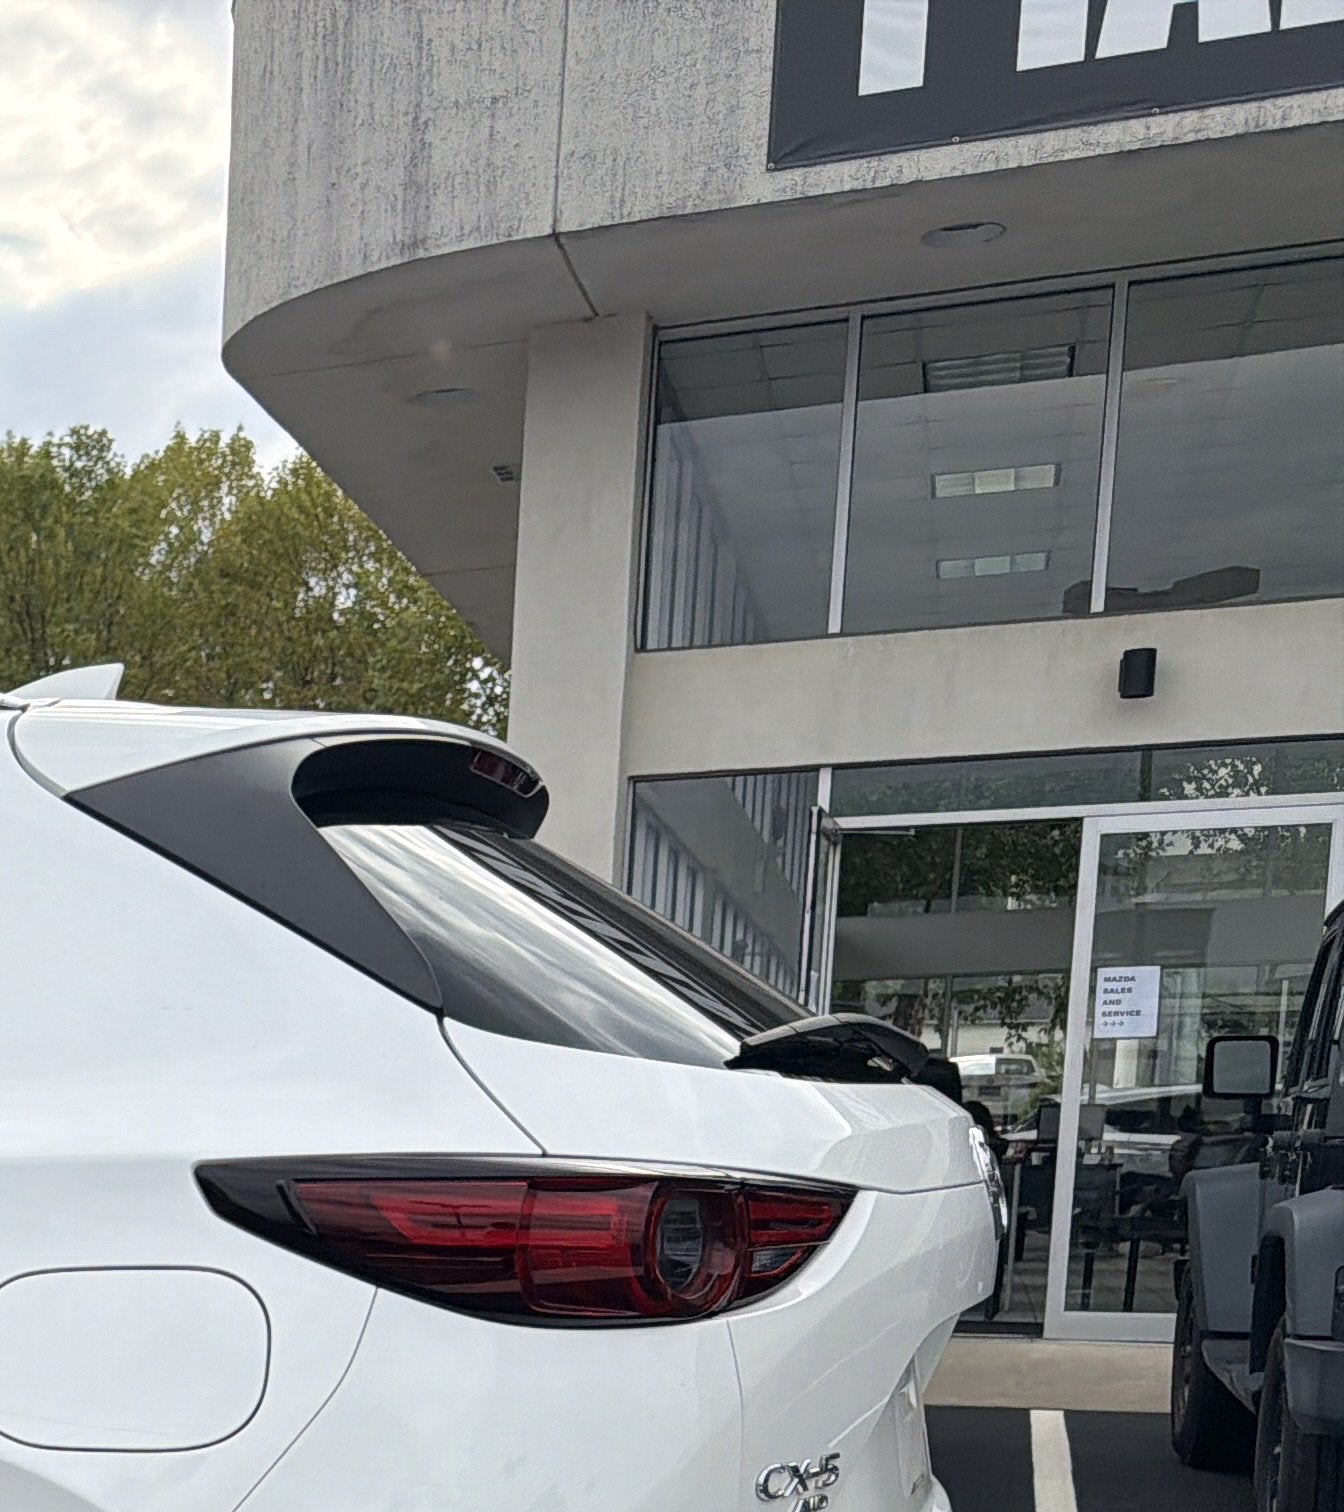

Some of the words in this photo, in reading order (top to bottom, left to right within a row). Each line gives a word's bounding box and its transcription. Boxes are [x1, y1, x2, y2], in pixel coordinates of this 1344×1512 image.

[1103, 975, 1137, 983] MAZDA
[1102, 987, 1133, 995] SALES
[1100, 1009, 1142, 1018] SERVICE
[755, 1452, 841, 1502] CX-5
